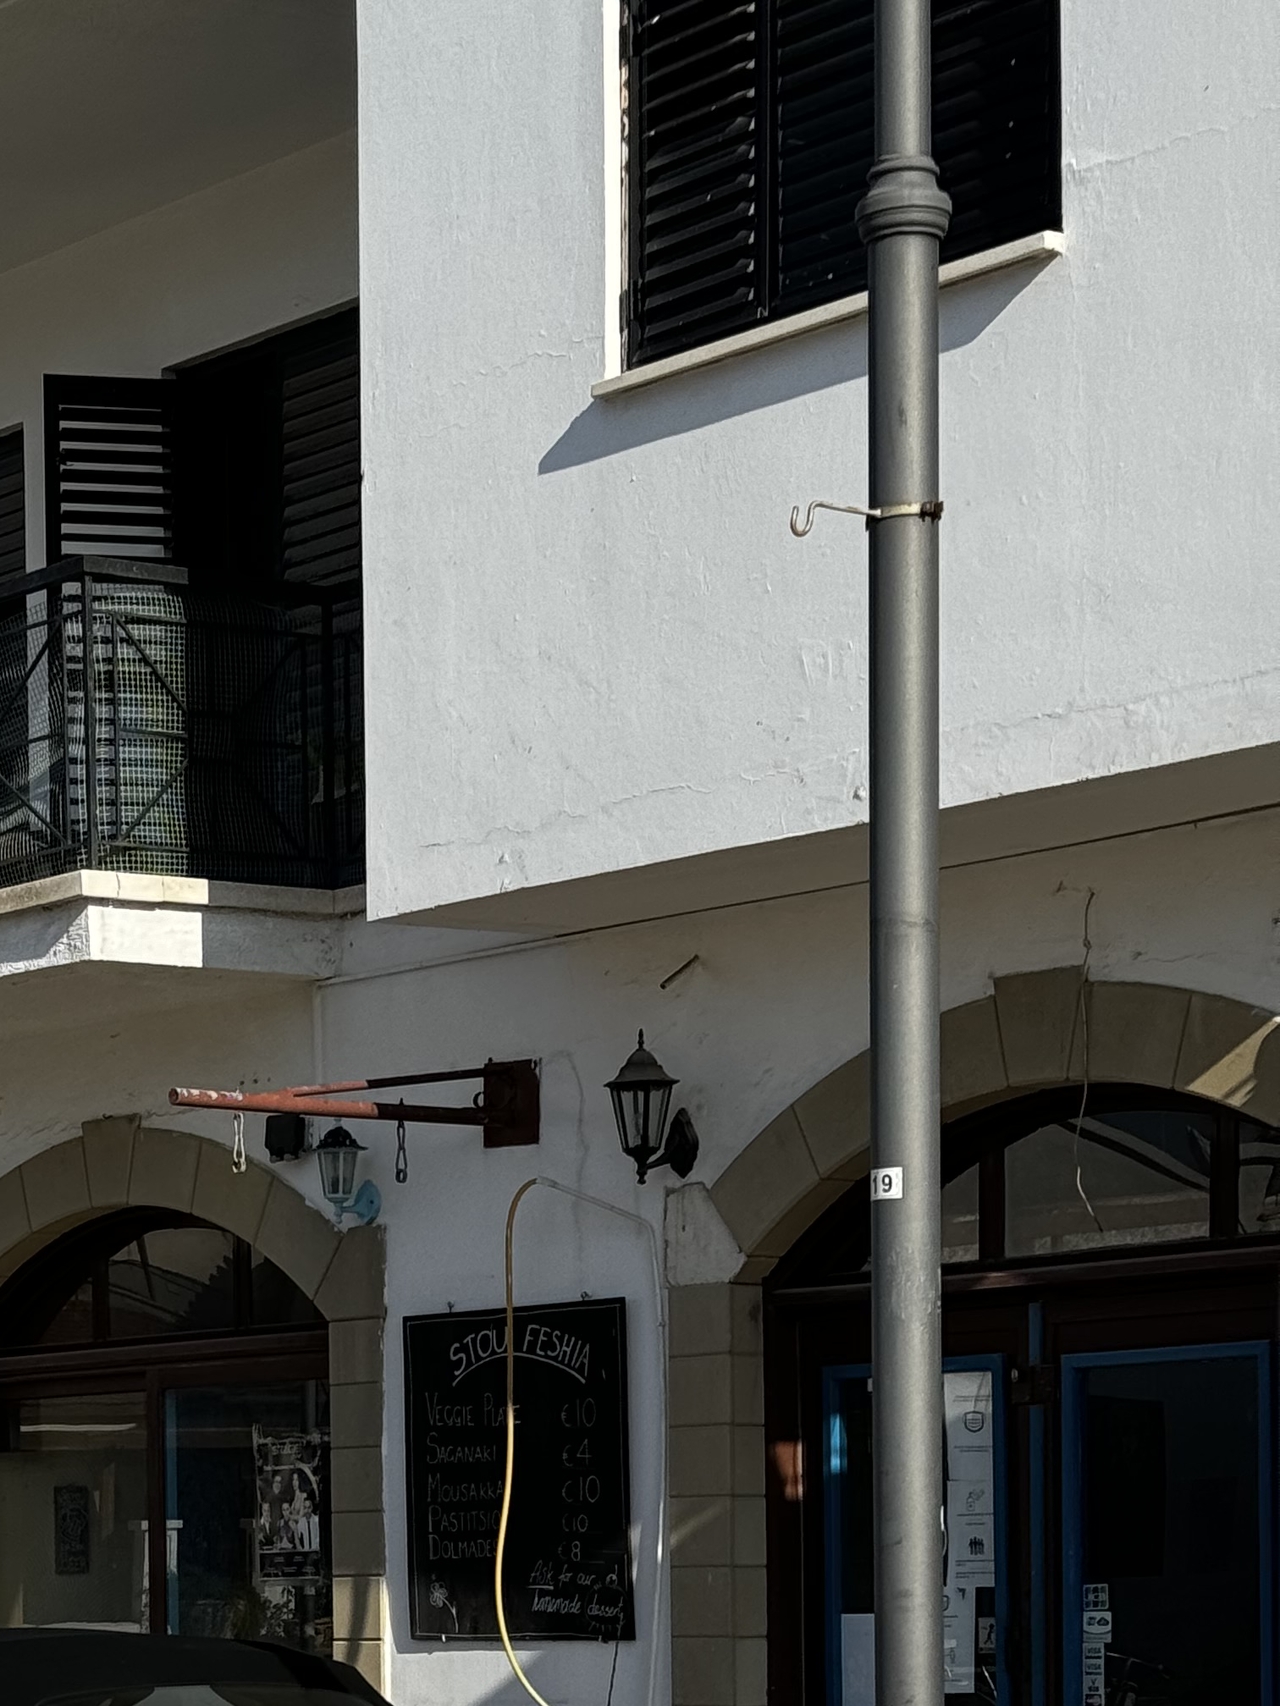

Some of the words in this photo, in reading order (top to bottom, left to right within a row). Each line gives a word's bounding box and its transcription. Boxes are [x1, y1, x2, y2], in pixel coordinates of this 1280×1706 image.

[873, 1174, 892, 1195] 19
[523, 1324, 590, 1377] FESHIA
[484, 1392, 521, 1427] PLAE
[561, 1397, 596, 1427] €10
[426, 1432, 496, 1464] SAGANAKI
[529, 1559, 555, 1585] Ask
[558, 1564, 573, 1589] for
[577, 1573, 596, 1585] our
